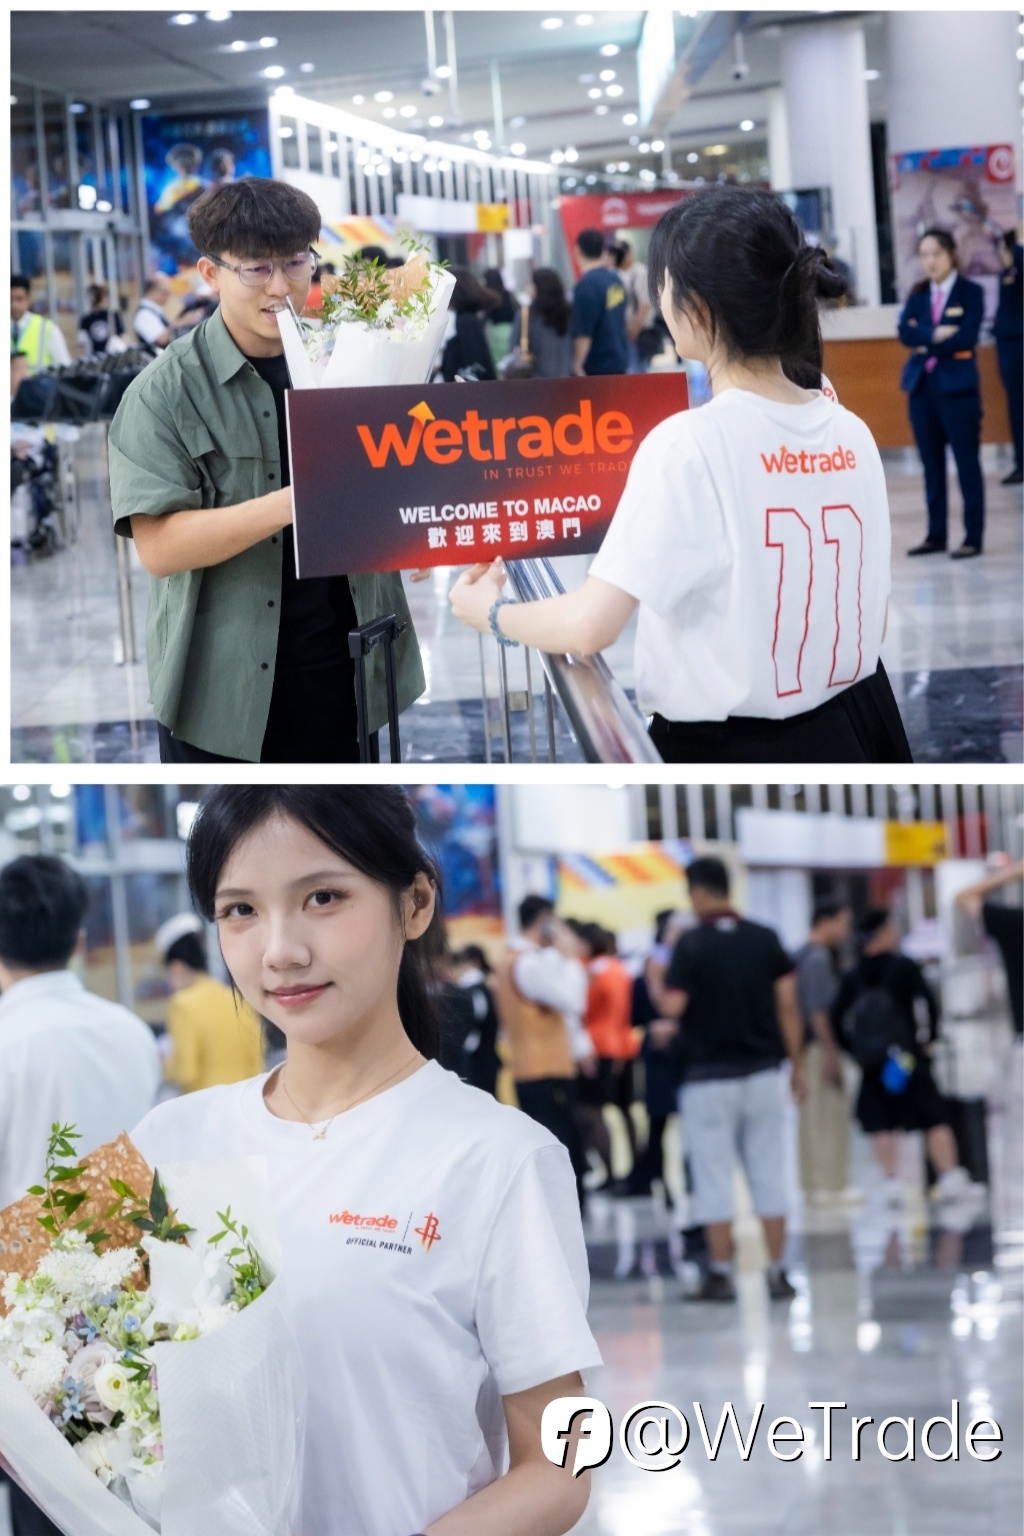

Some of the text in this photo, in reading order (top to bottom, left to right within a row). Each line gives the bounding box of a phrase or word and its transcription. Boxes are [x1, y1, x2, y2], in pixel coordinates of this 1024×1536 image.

[356, 400, 634, 468] wetrade
[484, 461, 632, 480] IN TRUST WE TRAD
[761, 445, 856, 474] wetrade
[399, 494, 601, 524] WELCOME TO MACAO
[427, 517, 581, 549] 歡迎來到澳門
[329, 1209, 399, 1229] wetrade
[345, 1237, 413, 1255] OFFICIAL PARTNER
